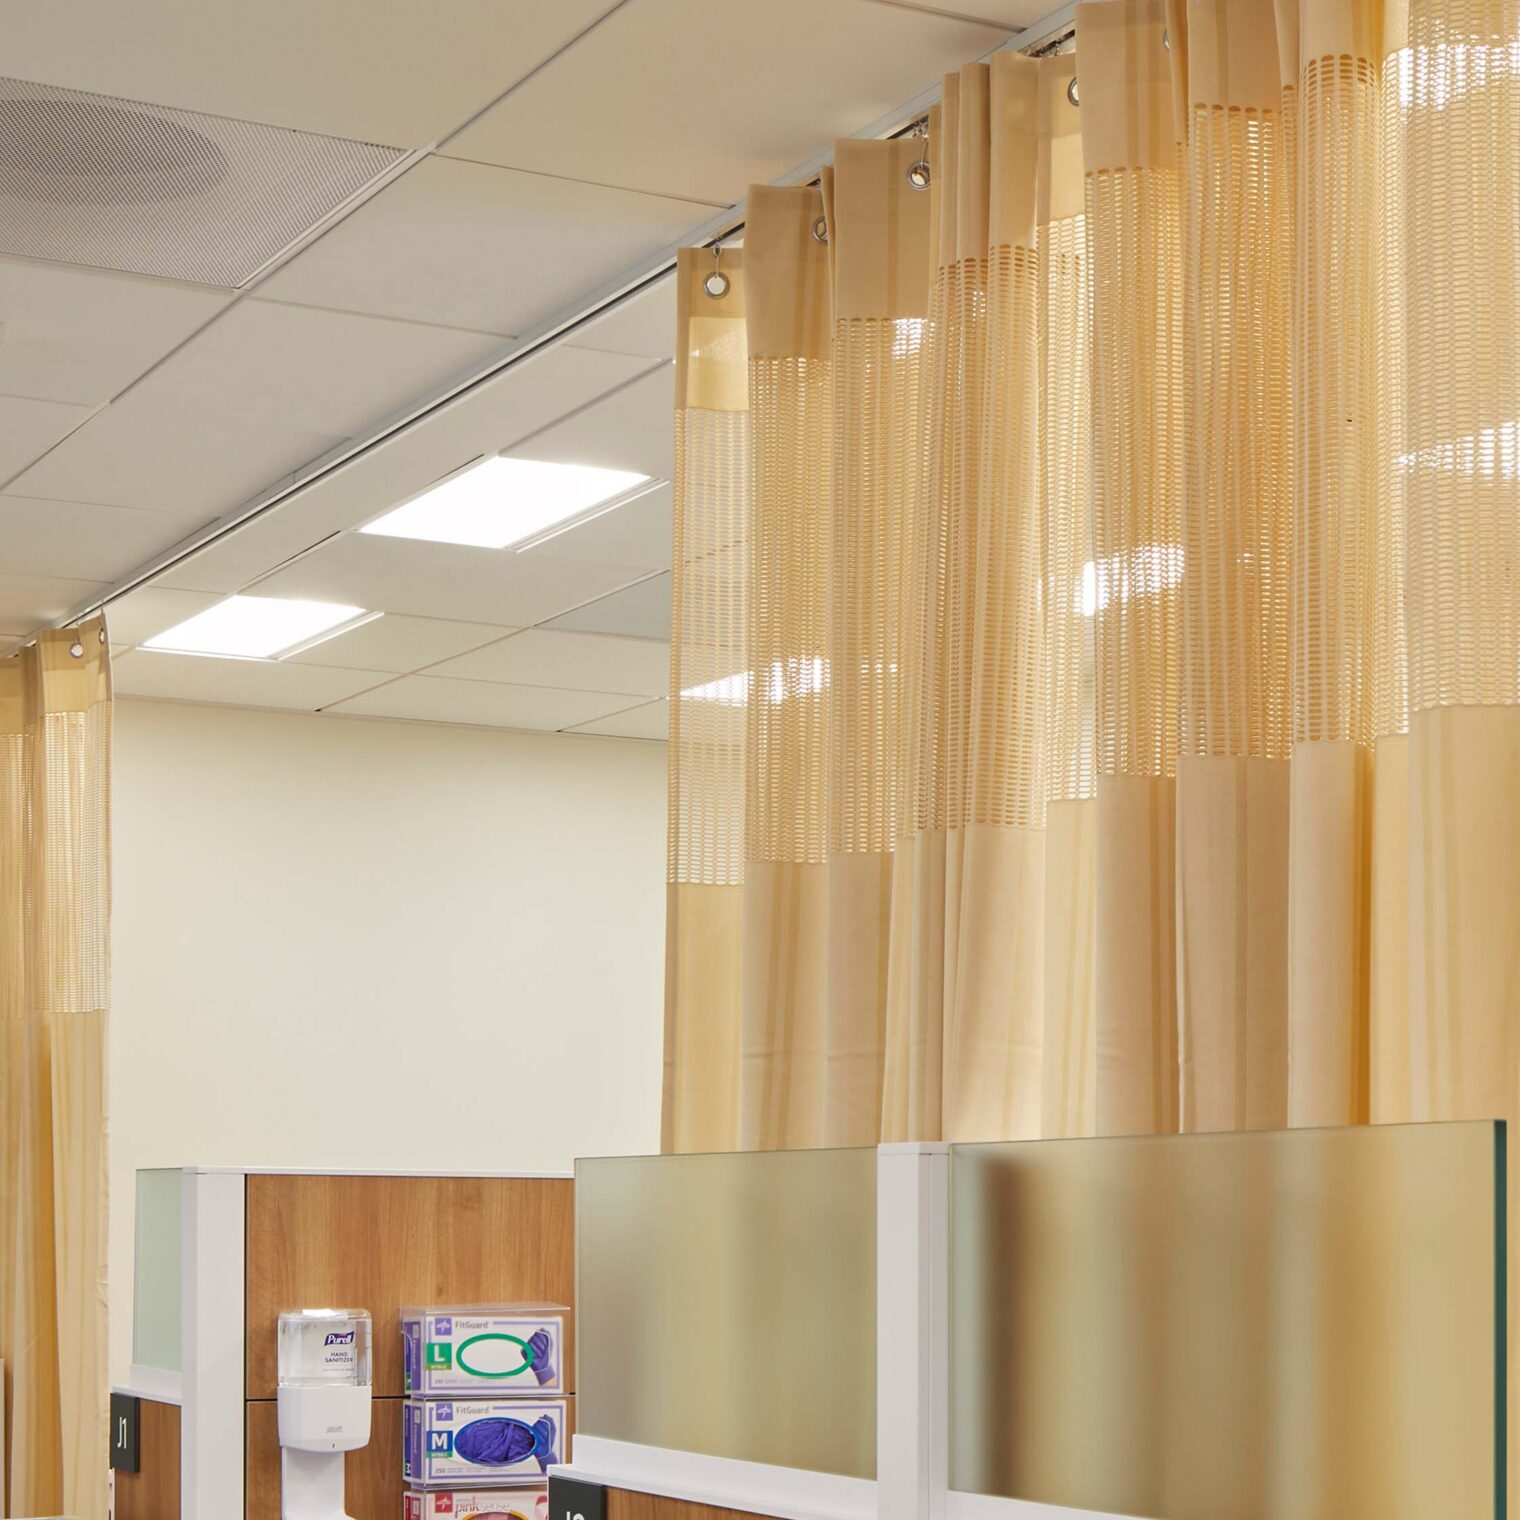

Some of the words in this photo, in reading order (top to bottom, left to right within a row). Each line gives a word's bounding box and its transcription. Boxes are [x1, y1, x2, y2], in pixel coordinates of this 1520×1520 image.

[455, 1321, 489, 1329] FitGuard
[327, 1334, 352, 1344] Purell
[434, 1345, 445, 1362] L
[456, 1407, 490, 1415] FitGuard
[117, 1416, 127, 1449] J1
[432, 1433, 448, 1450] M
